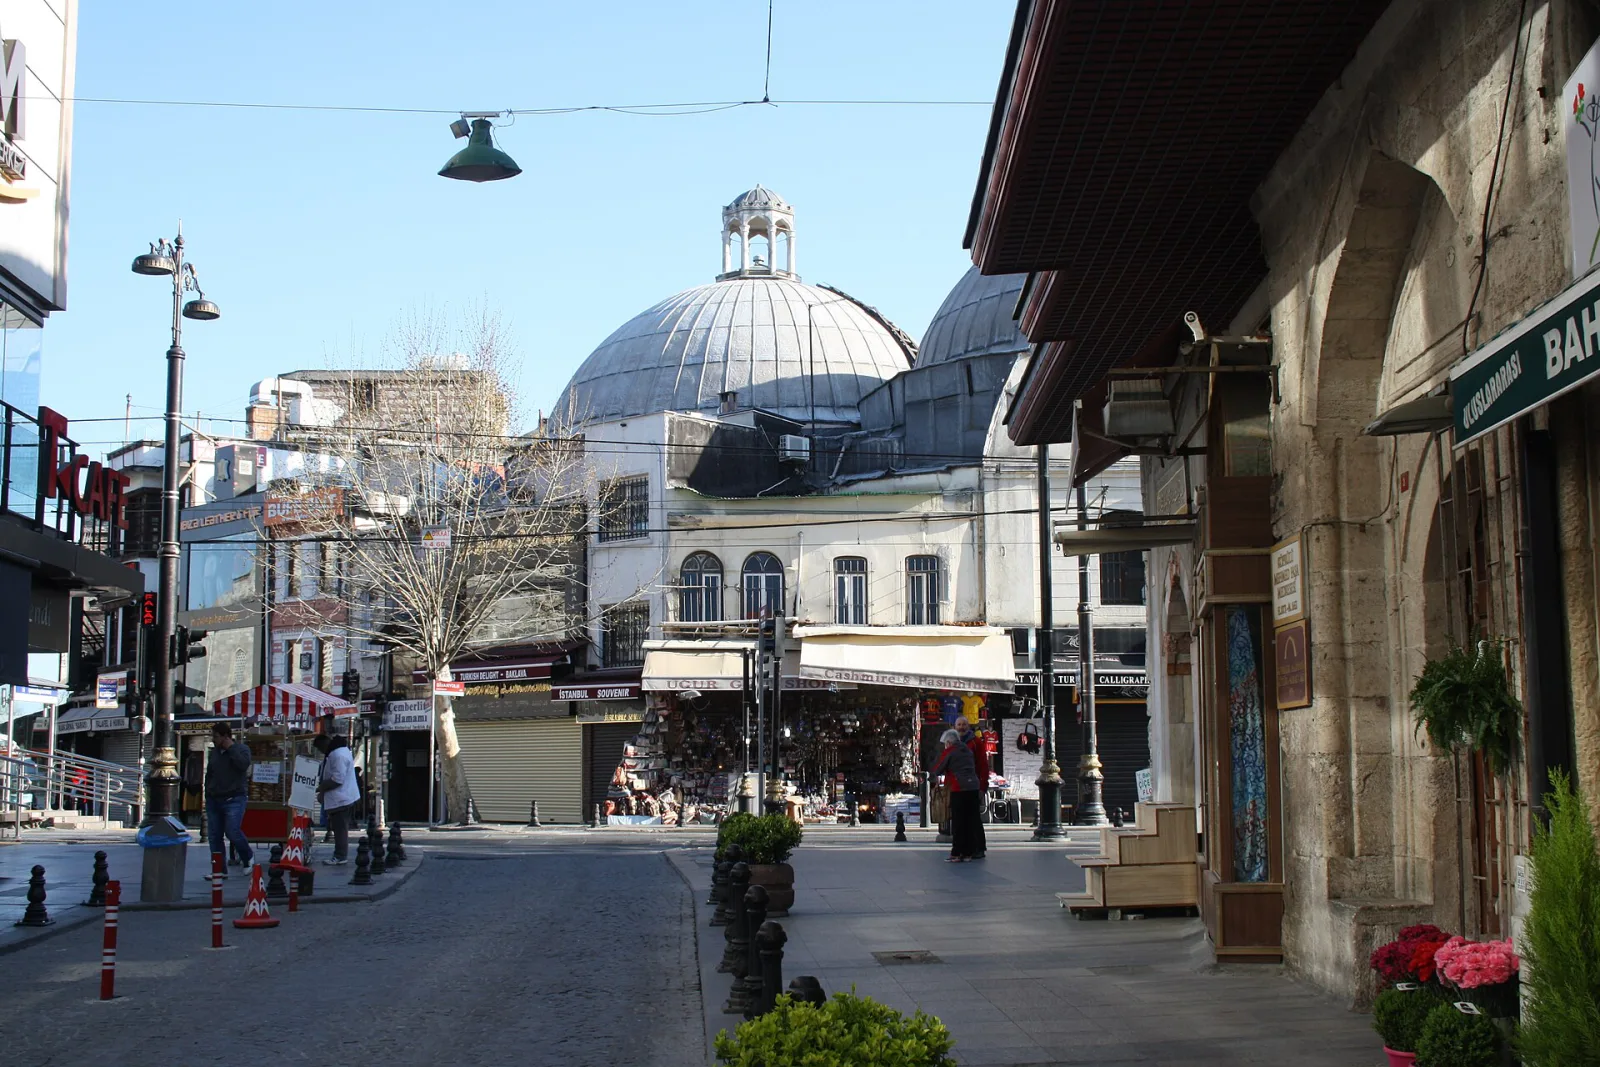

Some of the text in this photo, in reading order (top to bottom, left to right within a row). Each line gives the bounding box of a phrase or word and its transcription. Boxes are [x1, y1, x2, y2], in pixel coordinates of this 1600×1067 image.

[1462, 349, 1523, 430] ULUSLARARASI
[479, 670, 499, 680] DELIGHT
[505, 669, 527, 679] BAKLAVA
[824, 669, 896, 684] Cashmire
[559, 689, 589, 699] İSTANBUL
[597, 687, 630, 698] SOUVENIR
[294, 772, 317, 787] trend
